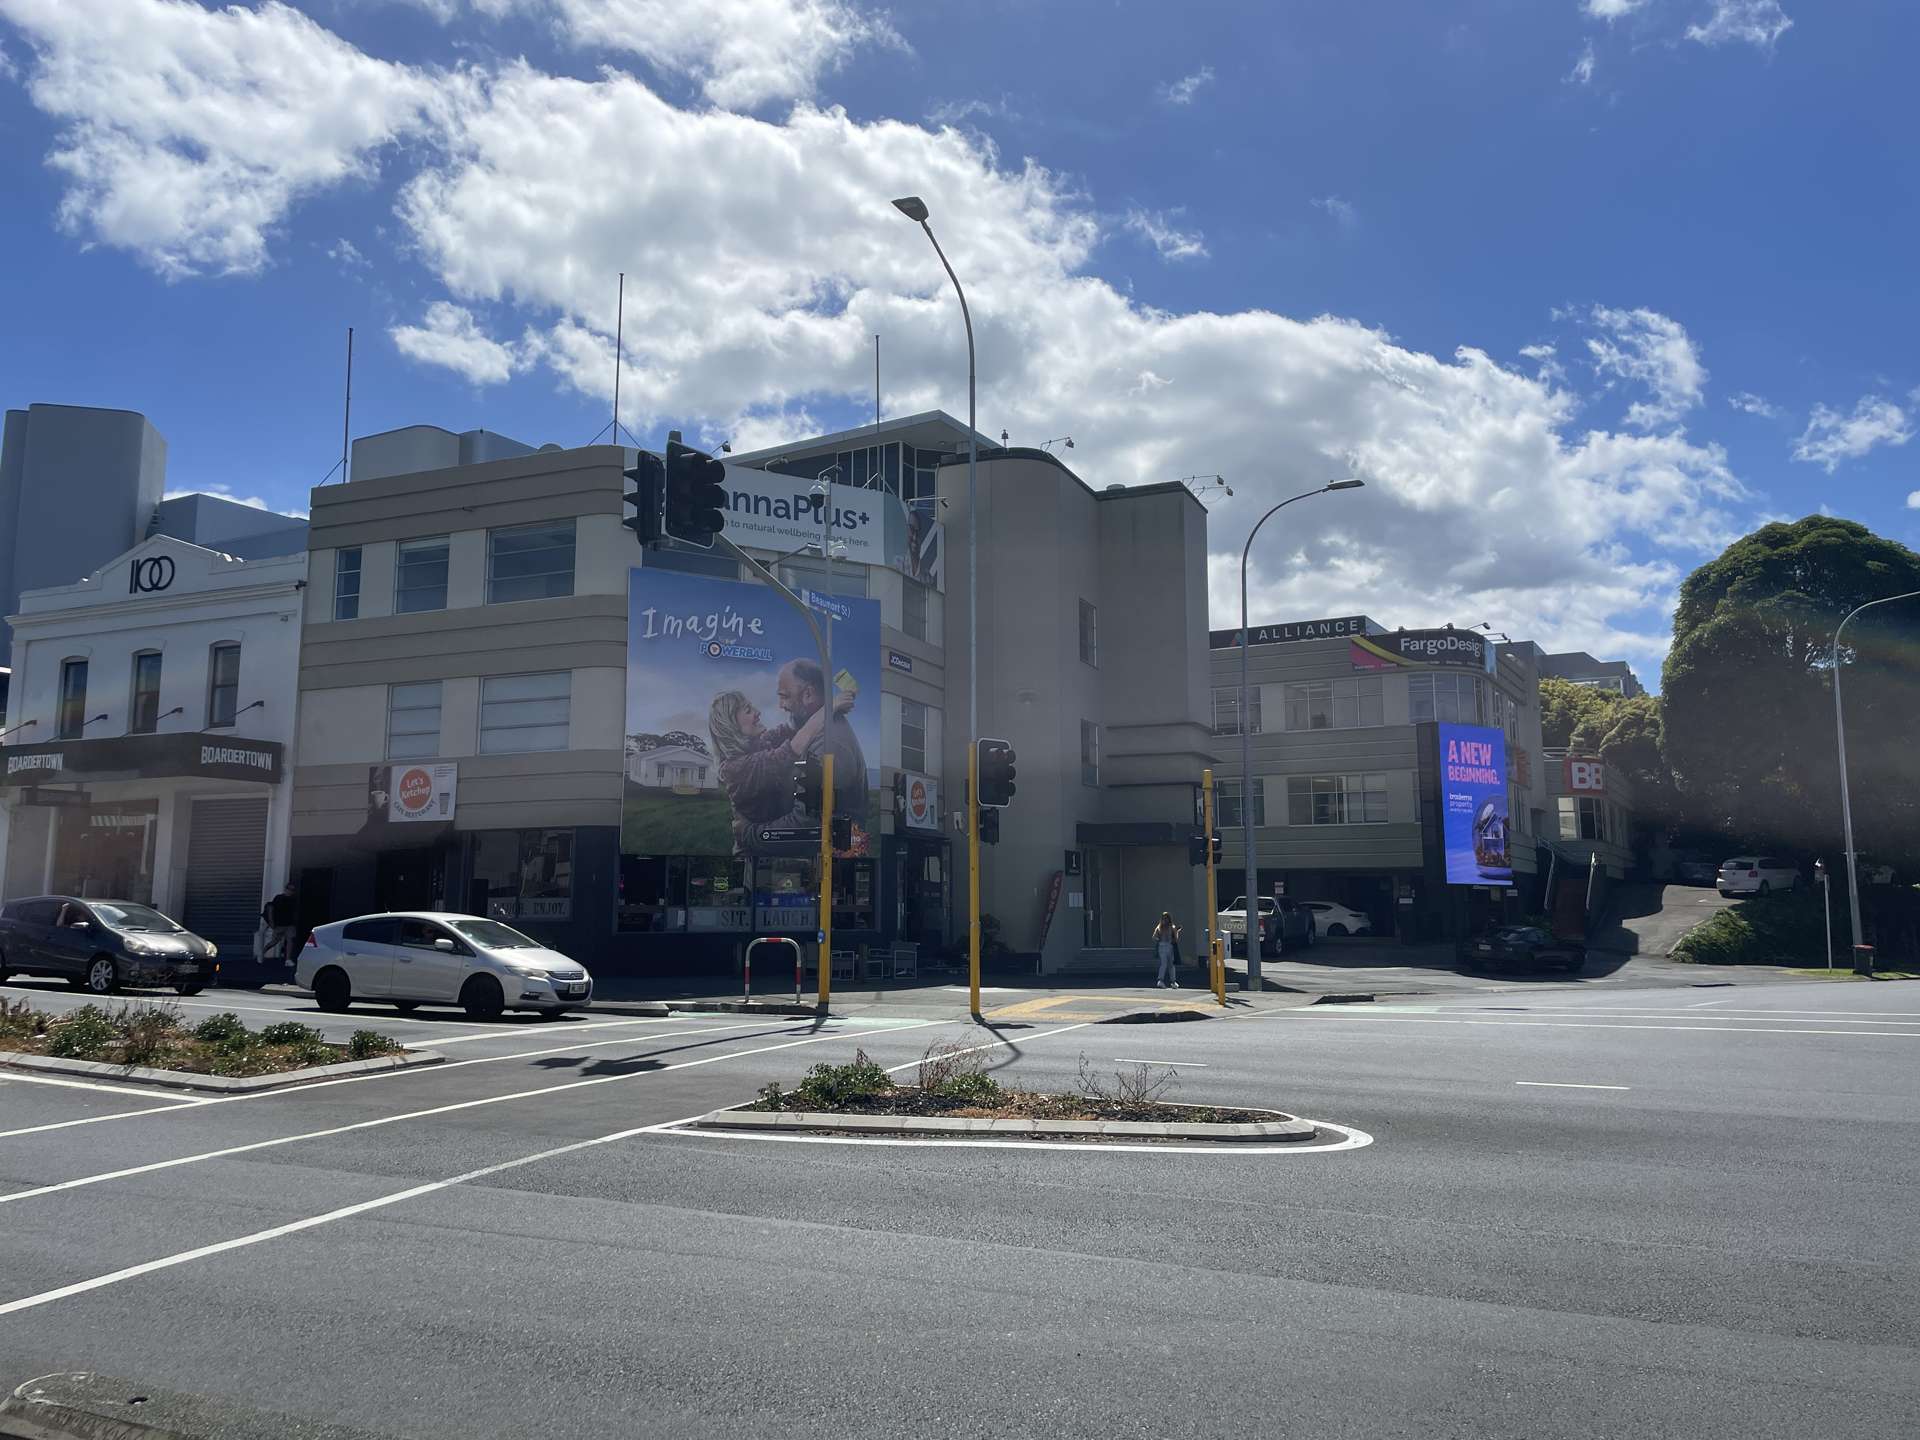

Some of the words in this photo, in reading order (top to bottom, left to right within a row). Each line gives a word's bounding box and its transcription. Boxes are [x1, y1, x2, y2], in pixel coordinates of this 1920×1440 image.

[731, 519, 740, 528] to
[743, 521, 775, 534] natural
[778, 527, 821, 541] wellbeing
[641, 605, 764, 640] Imagine
[1259, 620, 1359, 641] ALLIANCE
[699, 641, 773, 660] POWERBALL
[1400, 637, 1484, 657] FargoDesign
[8, 752, 64, 774] BOARDERTOWN
[201, 746, 272, 771] BOARDERTOWN
[1448, 740, 1459, 763] A
[1460, 741, 1492, 766] NEW
[1448, 765, 1500, 785] BEGINNING.
[721, 910, 750, 927] SIT.
[1224, 922, 1247, 931] TOYOT
